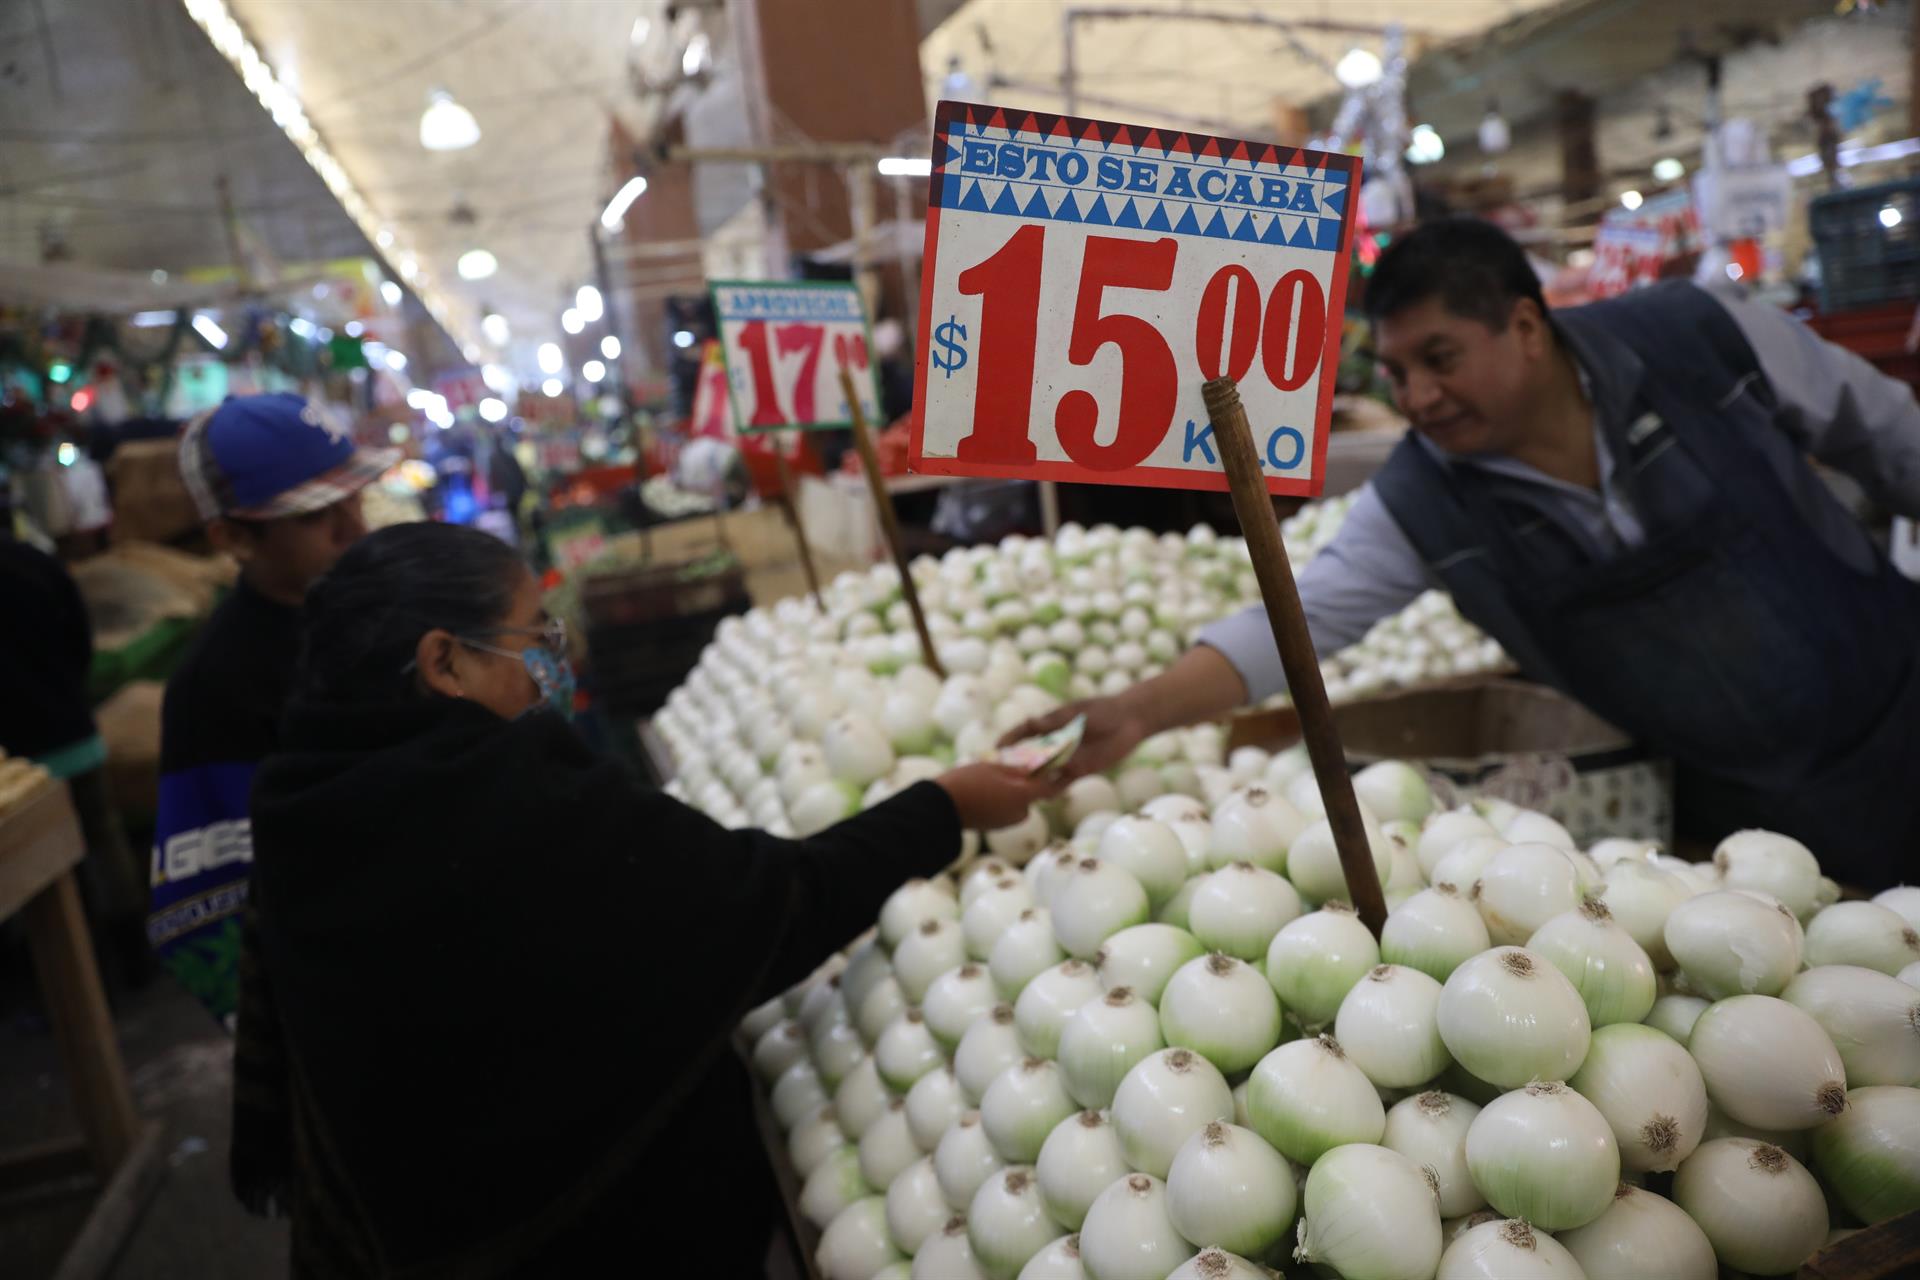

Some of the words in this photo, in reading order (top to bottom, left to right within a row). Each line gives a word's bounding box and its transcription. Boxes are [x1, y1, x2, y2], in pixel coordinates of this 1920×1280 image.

[963, 139, 1089, 186] ESTO
[1096, 155, 1158, 194] SE
[1163, 166, 1320, 214] ACABA
[932, 315, 968, 379] $
[1182, 419, 1305, 470] KO
